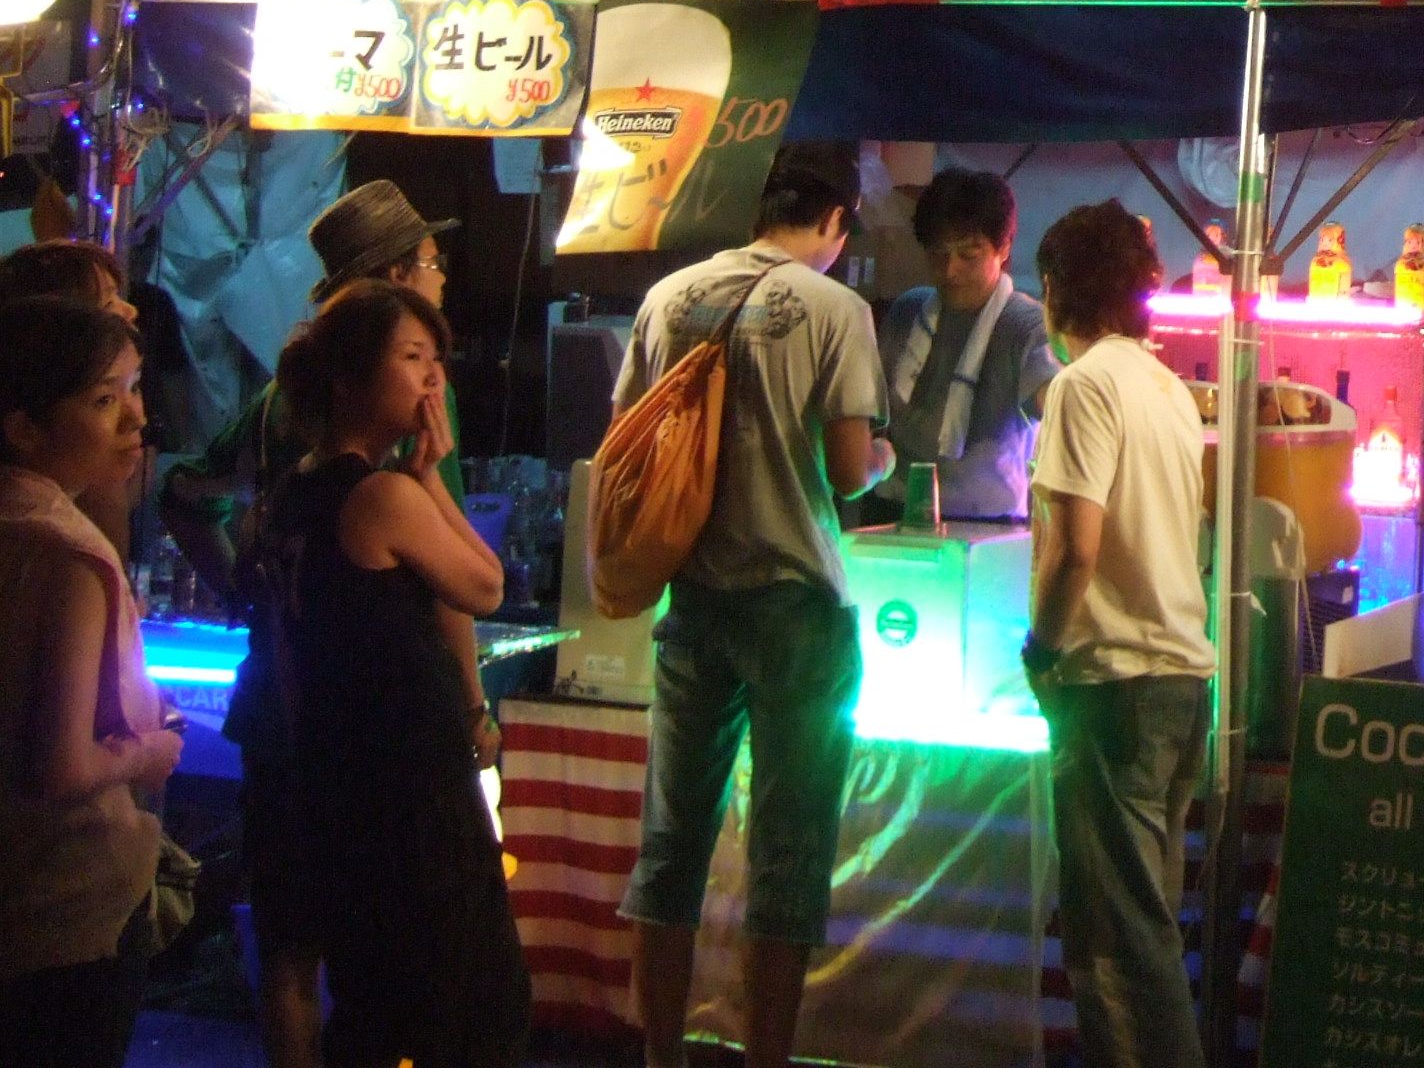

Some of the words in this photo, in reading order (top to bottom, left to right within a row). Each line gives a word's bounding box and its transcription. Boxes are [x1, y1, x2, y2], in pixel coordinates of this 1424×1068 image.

[433, 22, 554, 73] 生ビール
[597, 112, 673, 134] Heineken
[705, 96, 790, 150] 500
[1369, 793, 1415, 832] all
